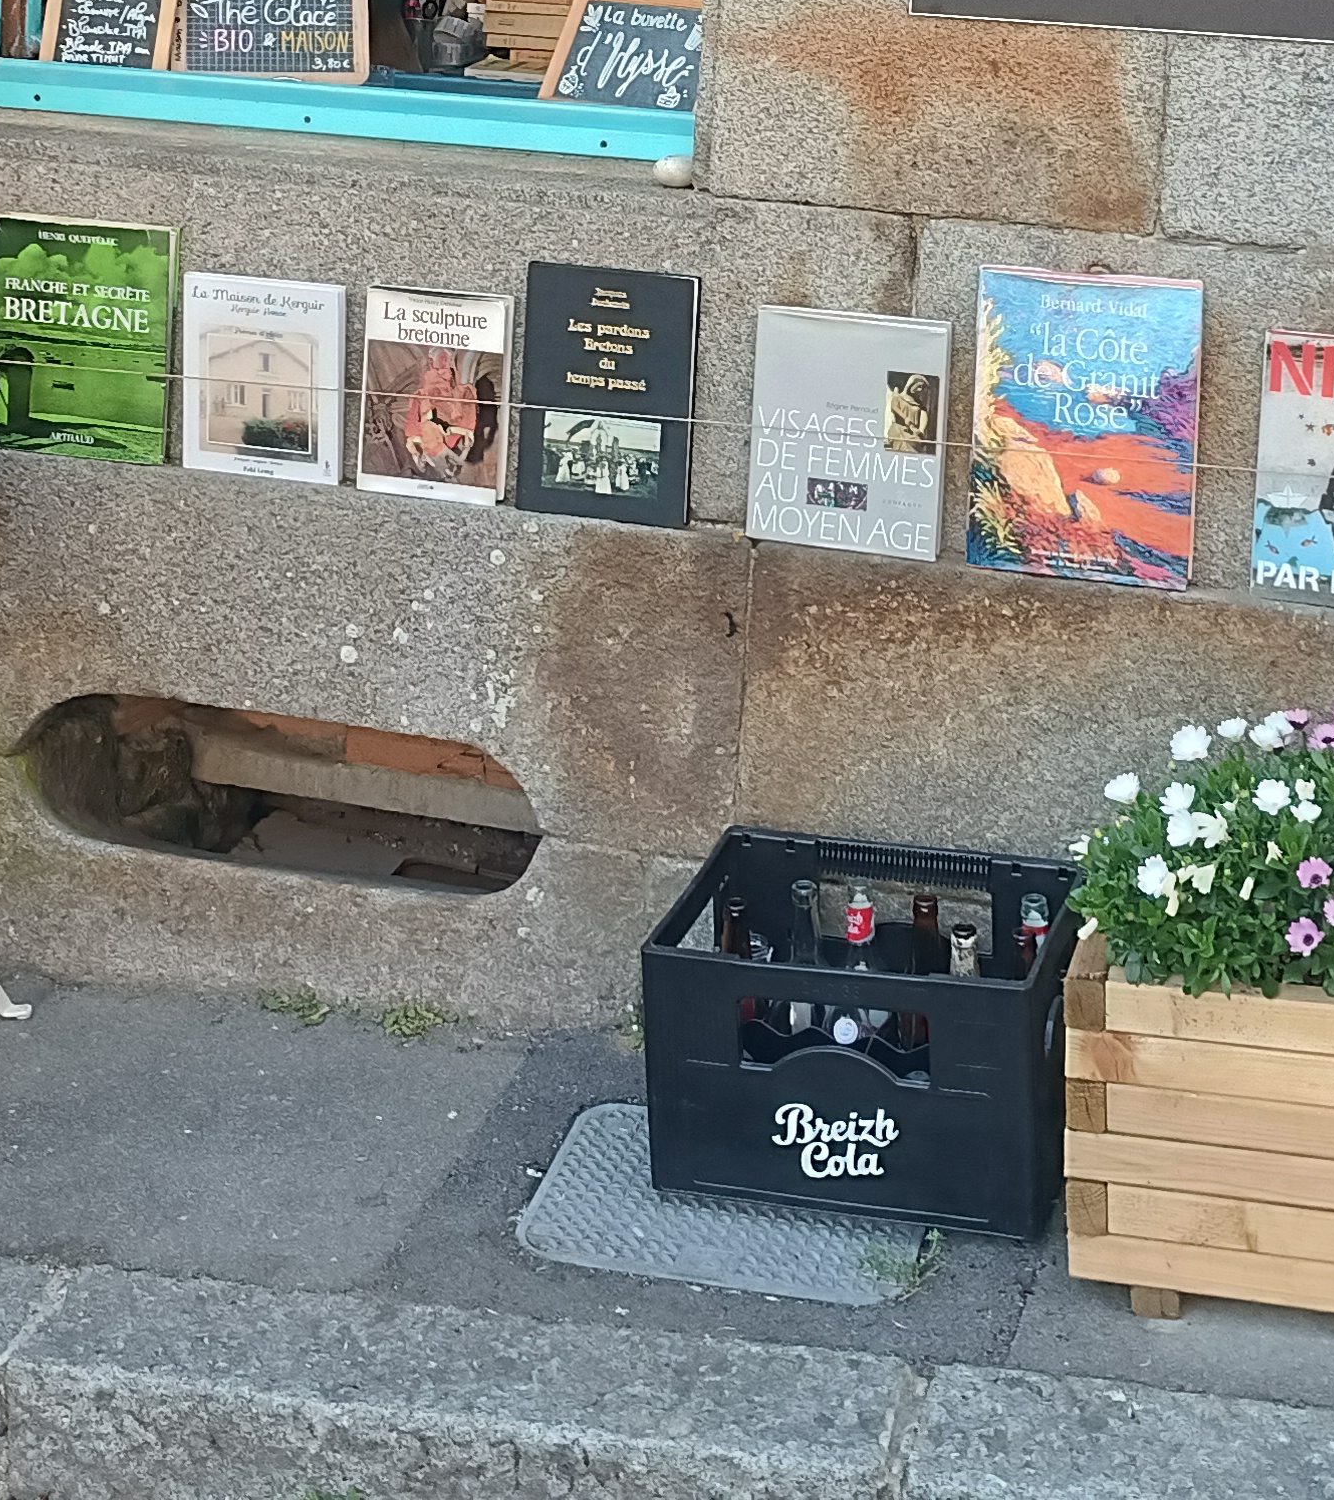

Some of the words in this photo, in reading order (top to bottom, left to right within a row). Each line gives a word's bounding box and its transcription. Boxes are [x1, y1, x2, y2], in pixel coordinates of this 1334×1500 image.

[630, 8, 688, 32] buvette
[213, 29, 254, 53] BIO
[5, 276, 68, 295] FRANCHE
[72, 283, 90, 296] ET
[93, 285, 151, 303] SECRÈTE
[192, 285, 209, 299] La
[212, 289, 261, 304] Maison
[264, 293, 277, 306] de
[4, 296, 150, 334] BRETAGNE
[383, 301, 407, 321] La
[412, 308, 488, 330] sculpture
[1040, 294, 1103, 313] Bernard
[1108, 300, 1149, 318] Vidal
[398, 322, 471, 347] bretonne
[598, 357, 616, 371] du
[1013, 353, 1053, 388] de
[1062, 360, 1161, 399] Granit
[758, 405, 878, 448] VISAGES
[756, 437, 798, 471] DE
[807, 444, 935, 488] FEMMES
[754, 471, 799, 503] AU
[752, 501, 861, 544] MOYEN
[866, 518, 932, 553] AGE
[1256, 560, 1319, 593] PAR
[772, 1103, 900, 1147] Breizh
[801, 1142, 885, 1179] Cola
